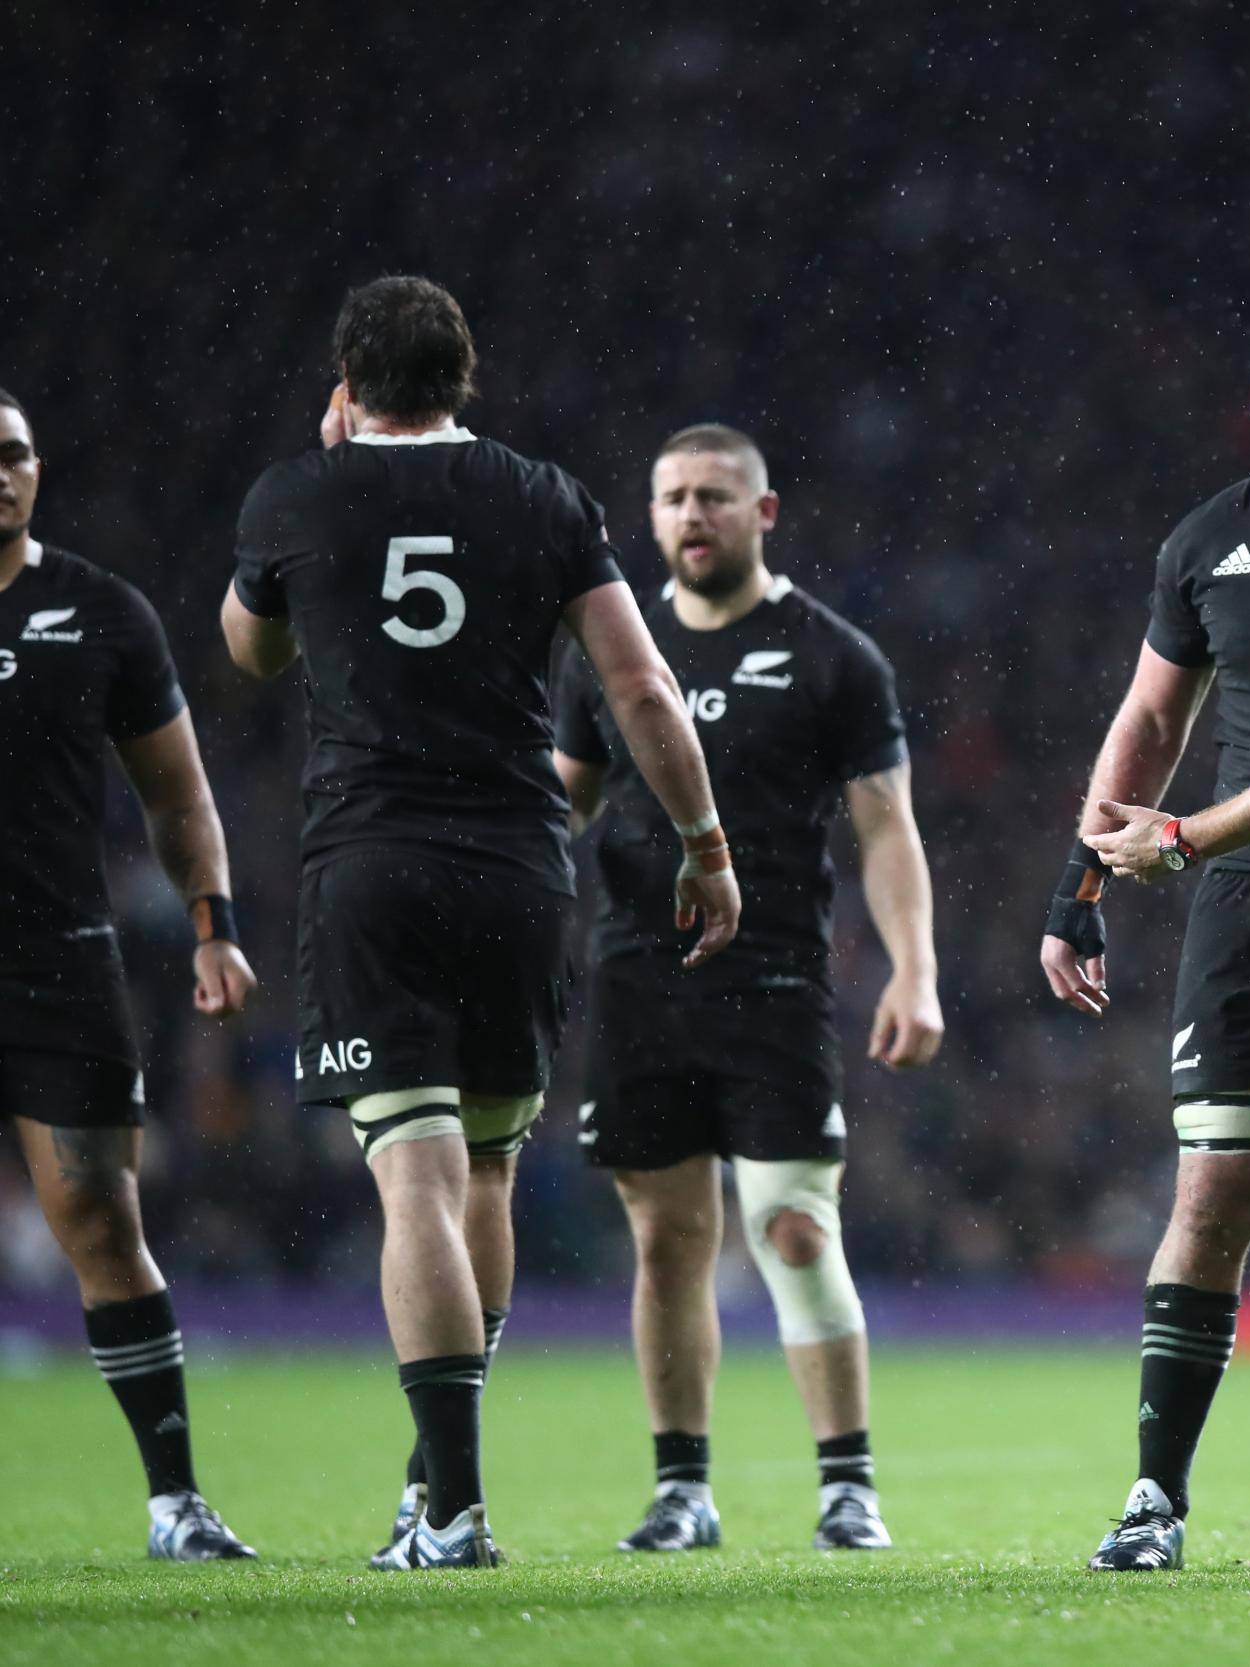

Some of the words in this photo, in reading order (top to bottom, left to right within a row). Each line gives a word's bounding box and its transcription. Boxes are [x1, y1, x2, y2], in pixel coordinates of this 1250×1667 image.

[381, 536, 466, 648] 5
[687, 688, 727, 722] IG
[319, 1037, 372, 1075] AIG
